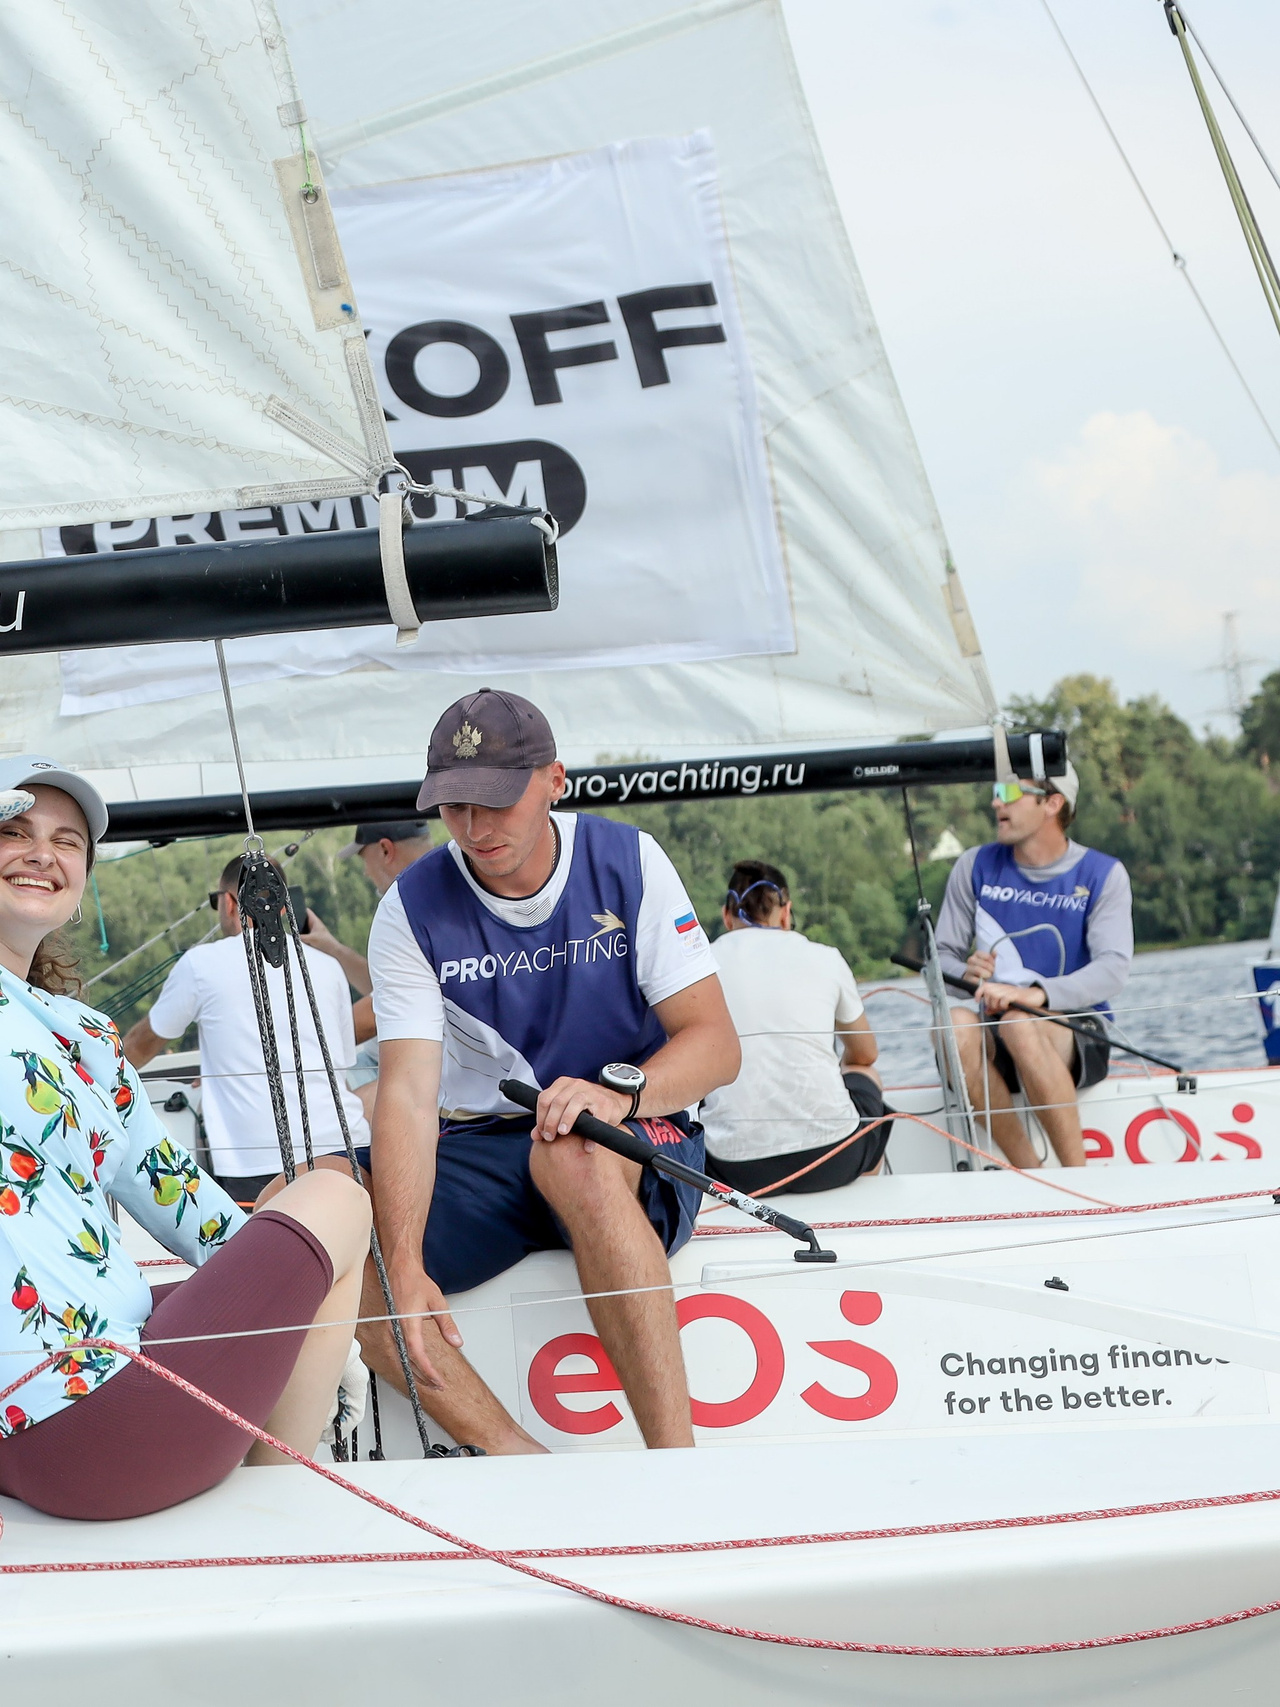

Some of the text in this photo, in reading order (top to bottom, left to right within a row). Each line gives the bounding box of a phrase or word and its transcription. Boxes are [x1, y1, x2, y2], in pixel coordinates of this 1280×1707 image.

[364, 281, 727, 418] OFF
[981, 884, 1089, 912] PROYACHTING
[439, 933, 628, 984] PROYACHTING
[940, 1344, 1231, 1378] Changing financ
[944, 1385, 1172, 1415] for the better.
